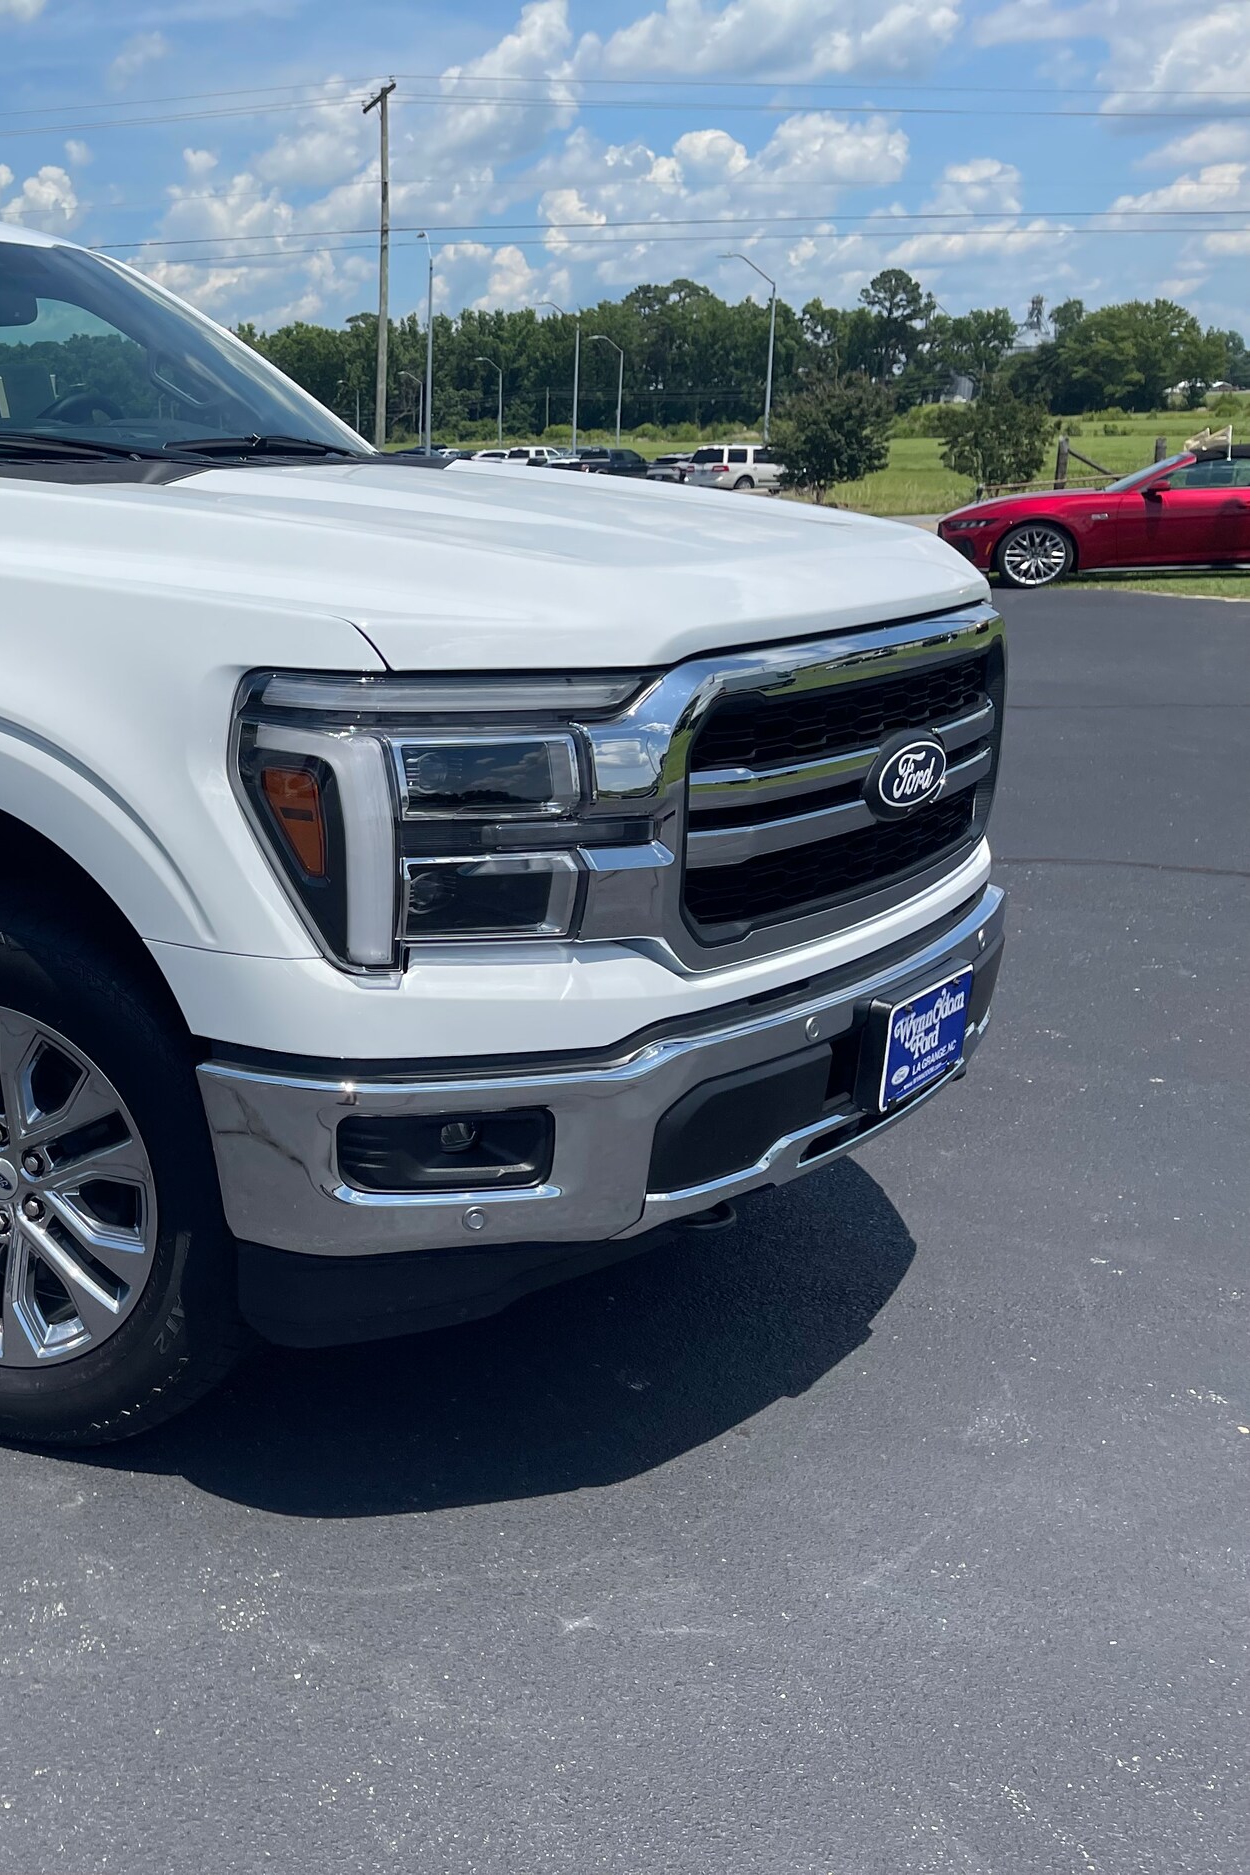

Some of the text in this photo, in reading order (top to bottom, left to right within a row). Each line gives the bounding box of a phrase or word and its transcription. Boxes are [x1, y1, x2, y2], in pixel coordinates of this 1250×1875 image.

[892, 750, 936, 799] Ford
[910, 1021, 940, 1060] Ford
[912, 1061, 921, 1076] LA
[947, 1039, 957, 1053] NC
